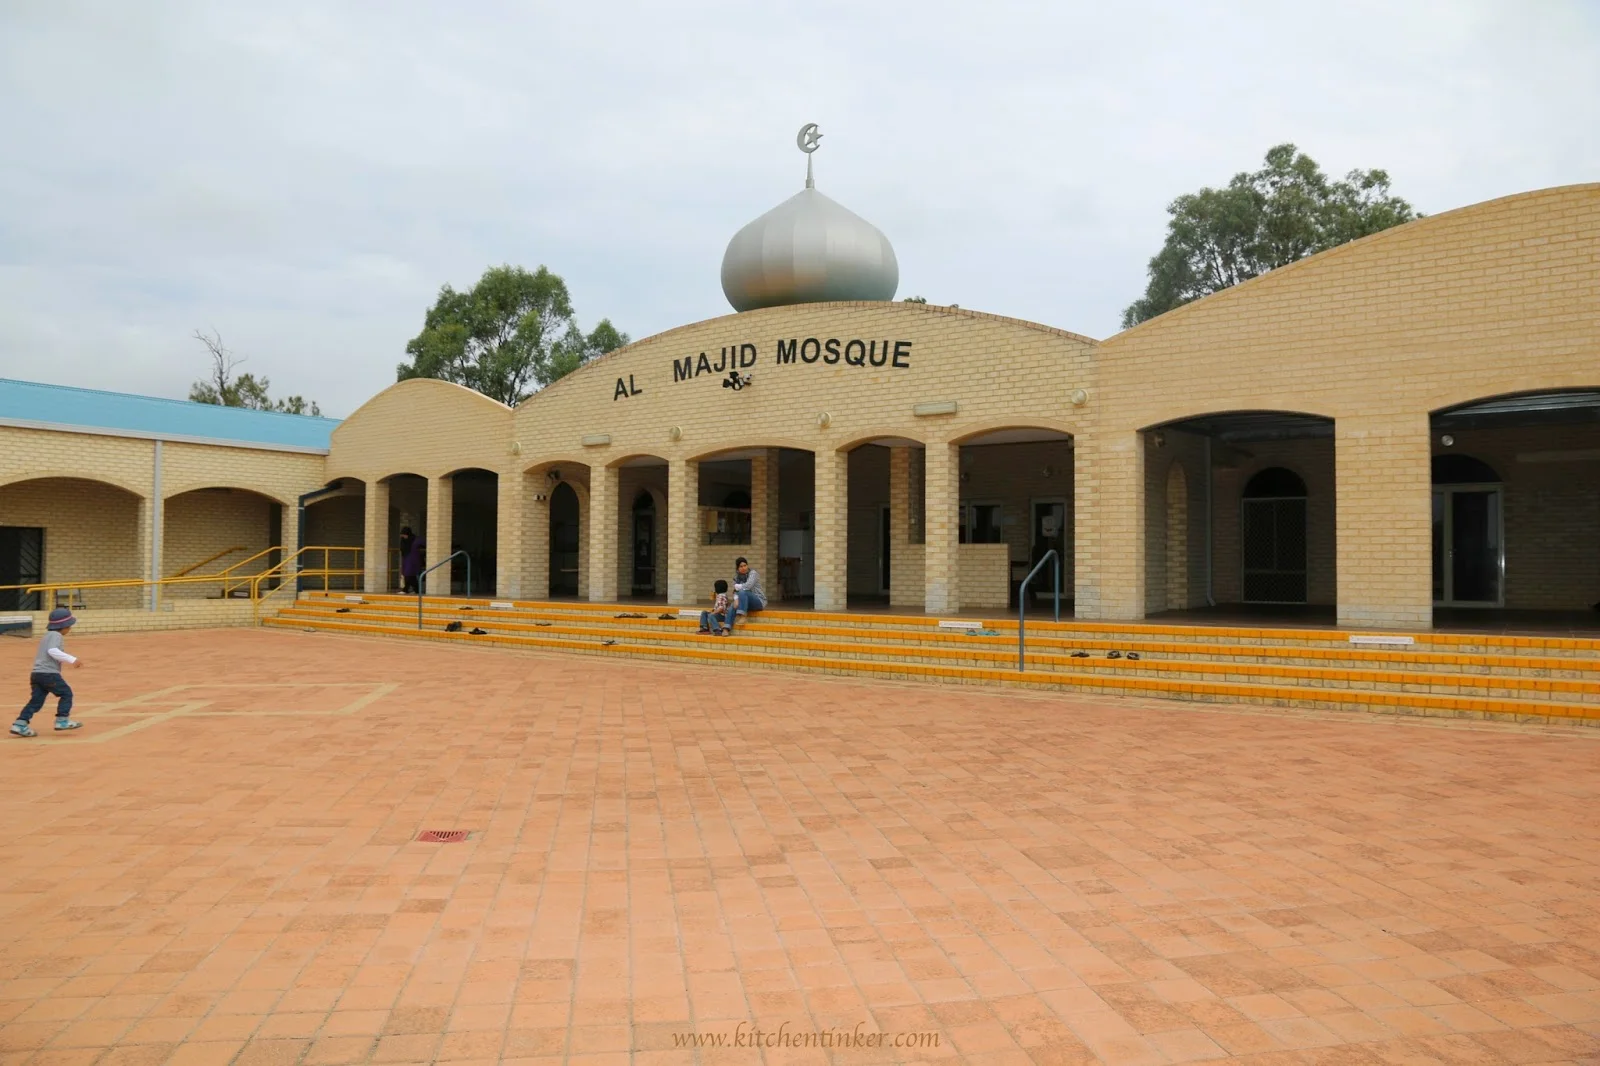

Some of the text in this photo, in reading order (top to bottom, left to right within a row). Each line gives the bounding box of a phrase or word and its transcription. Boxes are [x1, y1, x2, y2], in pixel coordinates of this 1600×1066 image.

[614, 337, 913, 401] AL MAJID MOSQUE
